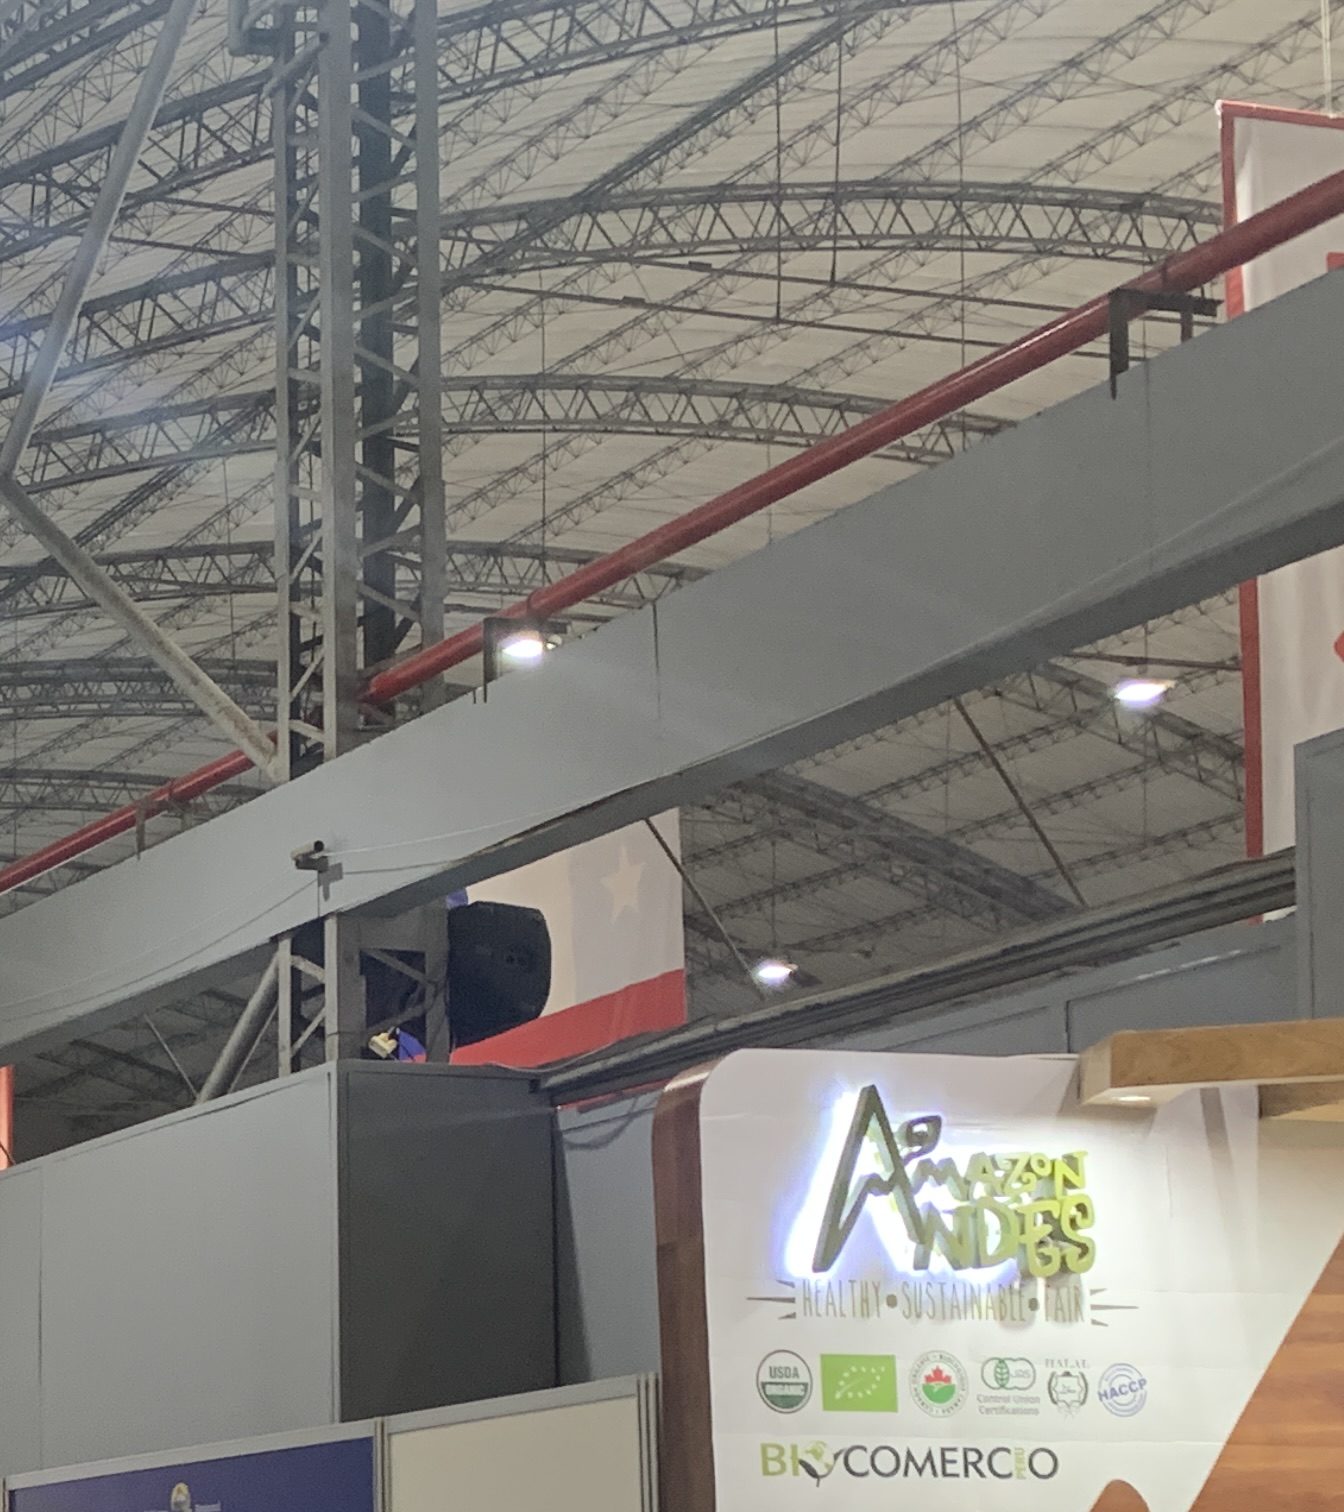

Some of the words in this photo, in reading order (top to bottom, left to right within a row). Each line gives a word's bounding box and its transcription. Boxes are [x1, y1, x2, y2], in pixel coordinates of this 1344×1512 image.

[802, 1279, 882, 1318] HEALTHY
[901, 1280, 1026, 1322] SUSTAINABLE
[1043, 1286, 1085, 1323] FAIR
[769, 1366, 800, 1379] USDA
[1098, 1378, 1148, 1402] HACCP
